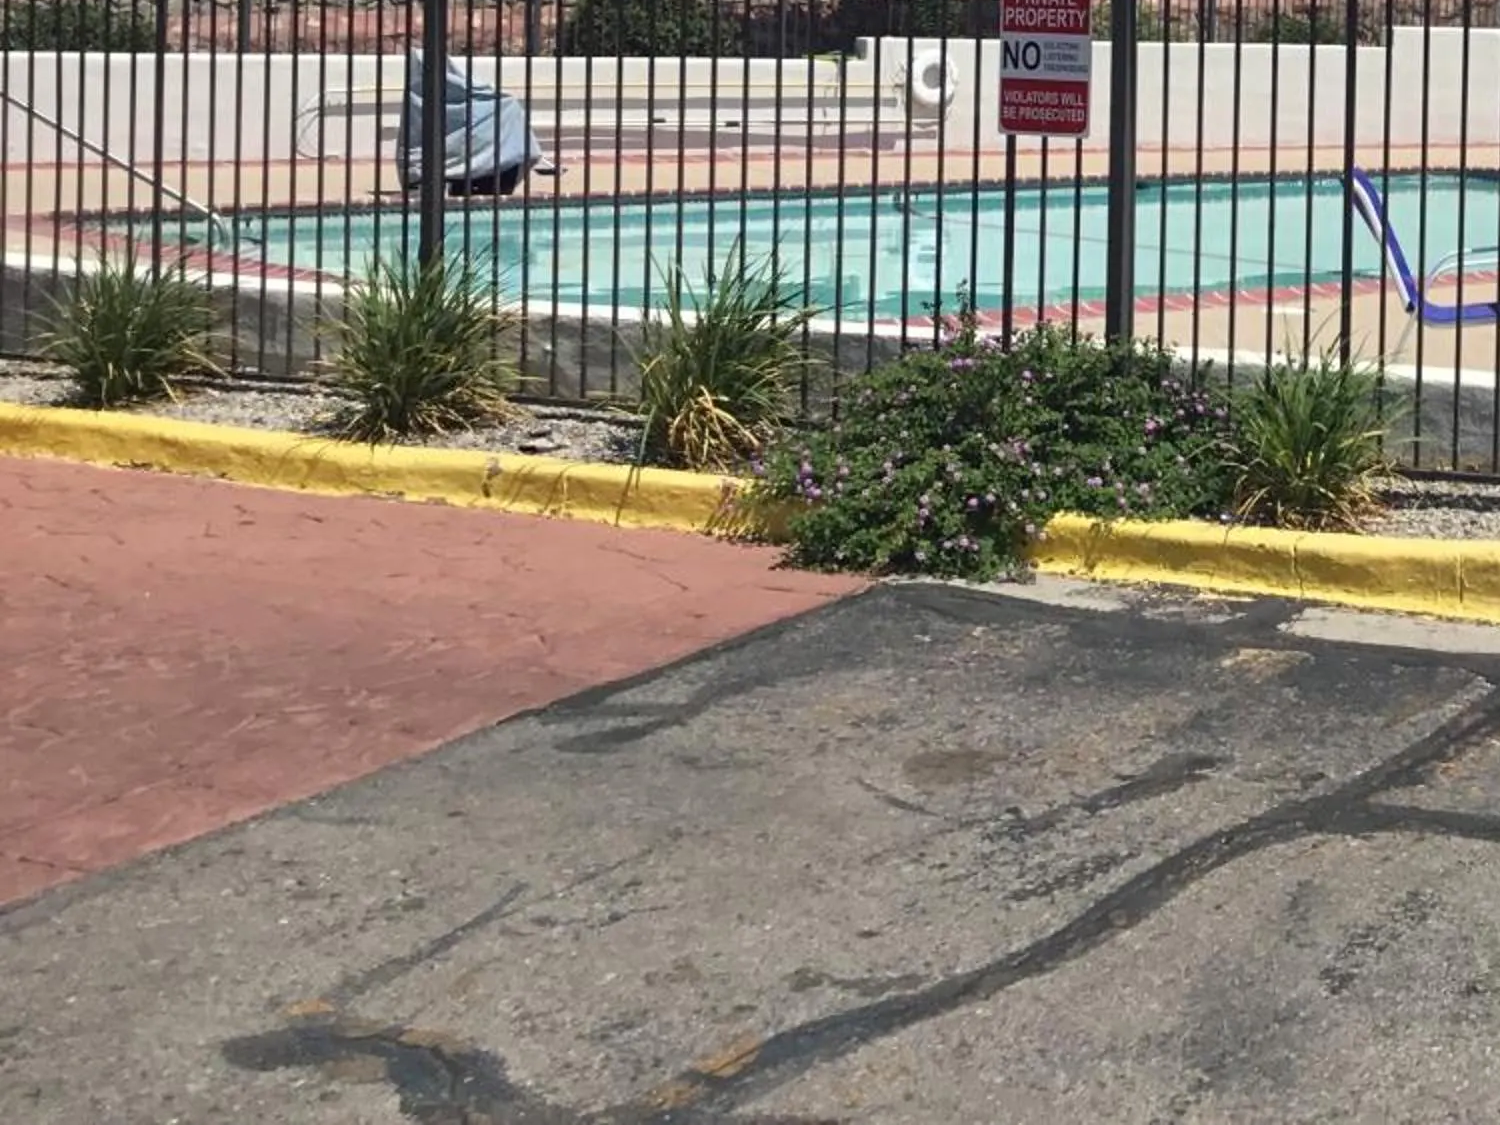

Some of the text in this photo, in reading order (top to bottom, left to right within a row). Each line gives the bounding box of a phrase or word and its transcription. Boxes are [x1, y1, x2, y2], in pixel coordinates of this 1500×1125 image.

[1004, 7, 1086, 28] PROPERTY
[1002, 41, 1042, 71] NO
[1003, 90, 1084, 106] VIOLATORS WILL
[1003, 106, 1085, 122] BE PROSECUTED
